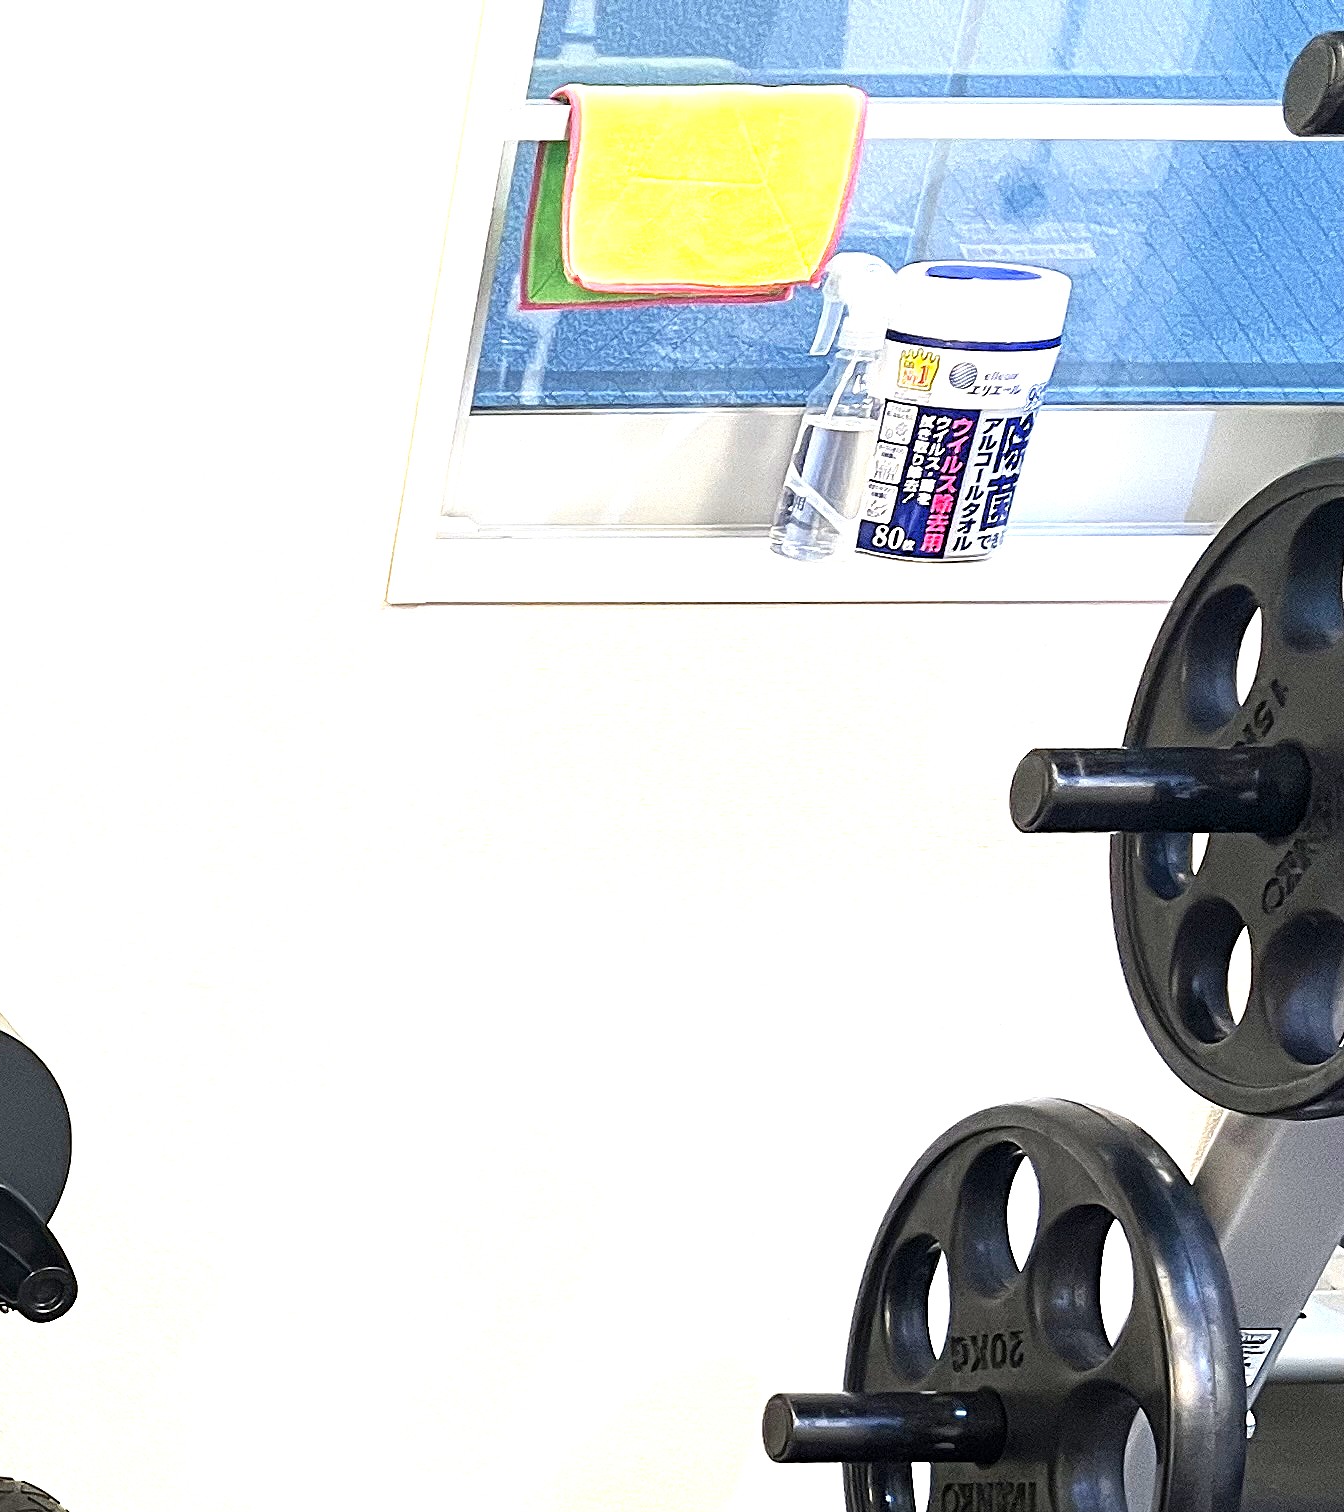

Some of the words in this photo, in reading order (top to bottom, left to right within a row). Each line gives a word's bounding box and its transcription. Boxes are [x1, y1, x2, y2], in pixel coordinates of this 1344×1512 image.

[952, 417, 1004, 552] アルコールタオル
